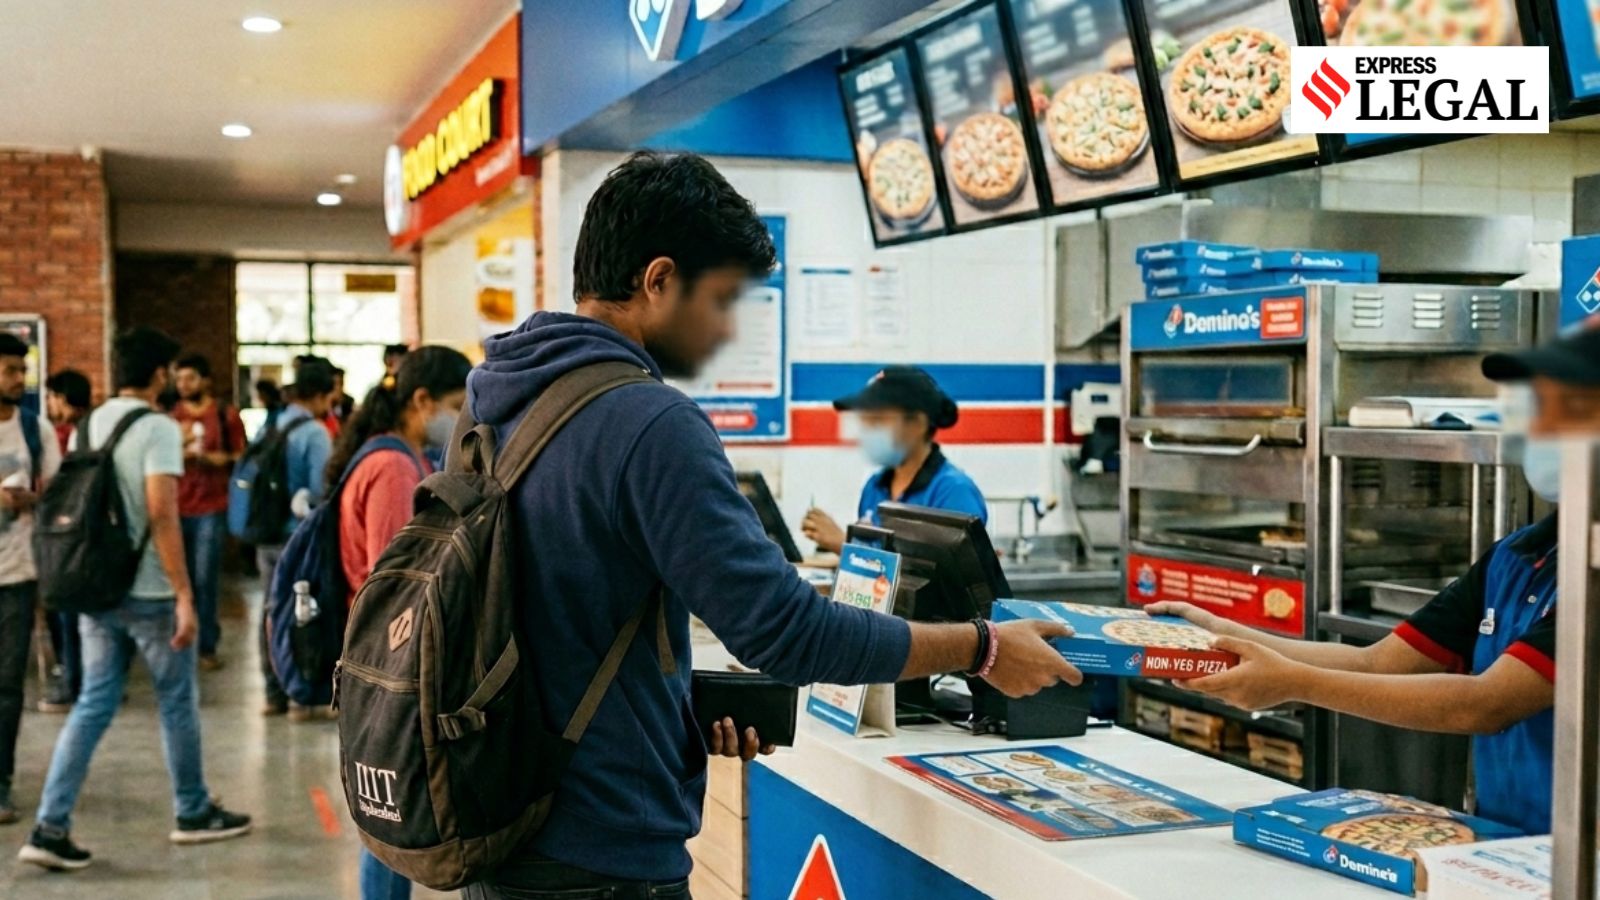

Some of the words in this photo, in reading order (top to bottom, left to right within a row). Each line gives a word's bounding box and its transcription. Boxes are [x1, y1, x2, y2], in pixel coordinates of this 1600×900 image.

[401, 133, 437, 201] FOOD
[436, 77, 494, 176] COURT
[1196, 660, 1228, 674] PIZZA
